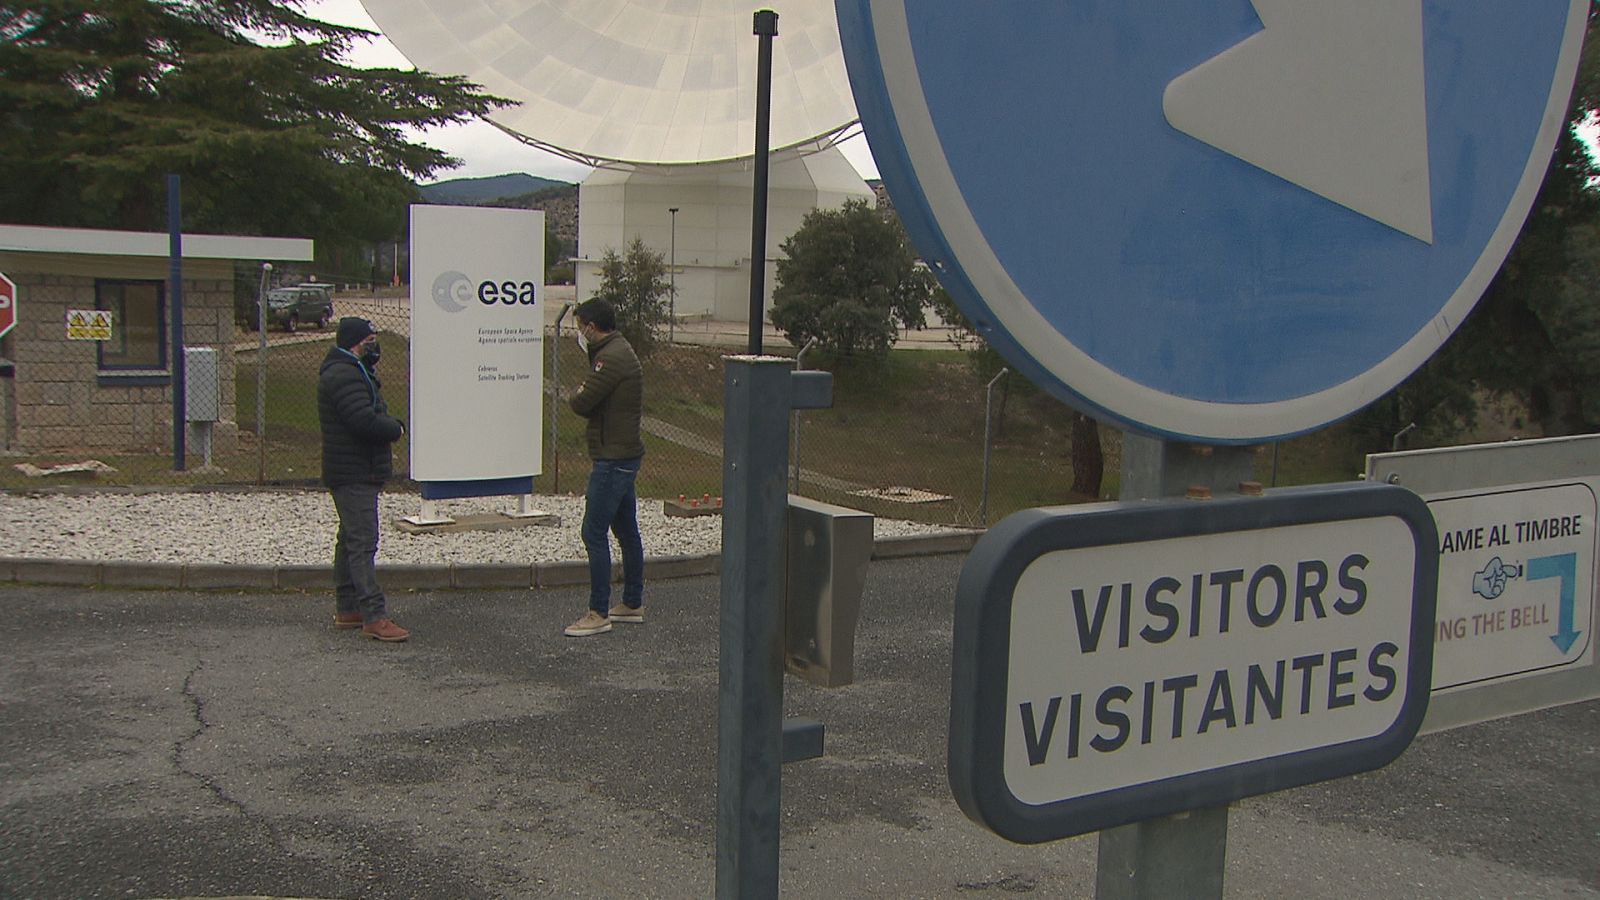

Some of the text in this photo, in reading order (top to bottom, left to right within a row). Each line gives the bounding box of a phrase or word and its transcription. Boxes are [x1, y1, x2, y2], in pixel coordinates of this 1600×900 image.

[478, 280, 535, 305] esa
[1440, 515, 1581, 554] AME AL TIMBRE
[1071, 554, 1370, 653] VISITORS
[1434, 604, 1549, 642] ING THE BELL
[1019, 642, 1399, 766] VISITANTES
